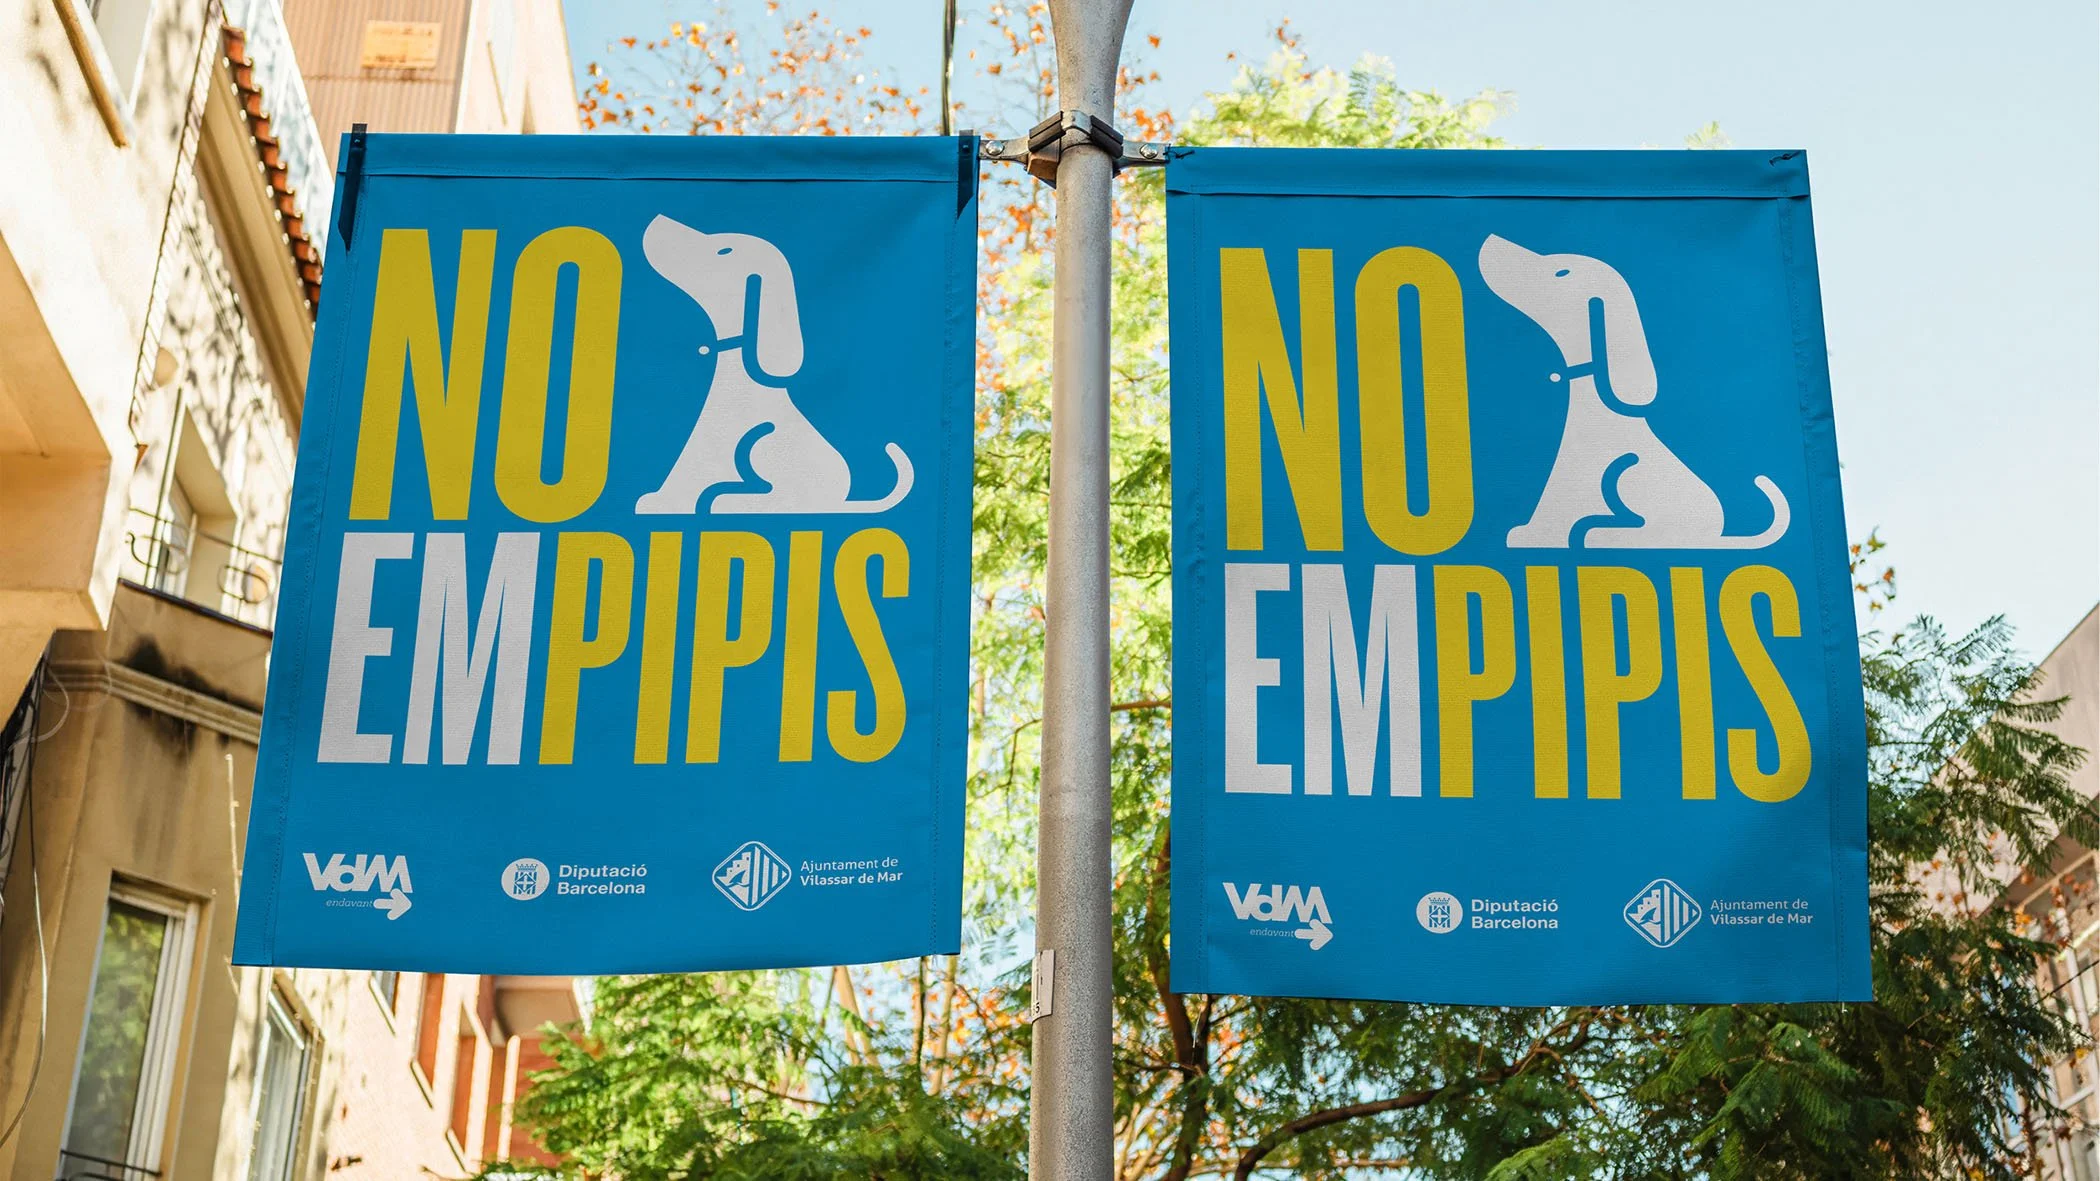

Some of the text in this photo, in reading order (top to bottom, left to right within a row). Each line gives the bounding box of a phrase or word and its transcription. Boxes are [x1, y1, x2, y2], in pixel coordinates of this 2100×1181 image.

[348, 225, 623, 524] NO
[1219, 245, 1475, 557] NO
[317, 527, 910, 766] EMPIPIS
[1224, 562, 1812, 804] EMPIPIS
[302, 852, 413, 894] VdM
[559, 863, 648, 881] Diputació
[800, 856, 899, 874] Ajuntament de
[800, 871, 904, 886] Vilassar de Mar
[557, 881, 647, 896] Barcelona
[325, 897, 374, 909] endavant
[1222, 882, 1334, 925] VdM
[1471, 898, 1559, 916] Diputació
[1710, 898, 1809, 913] Ajuntament de
[1471, 916, 1559, 930] Barcelona
[1710, 912, 1814, 925] Vilassar de Mar
[1249, 927, 1296, 938] endavant
